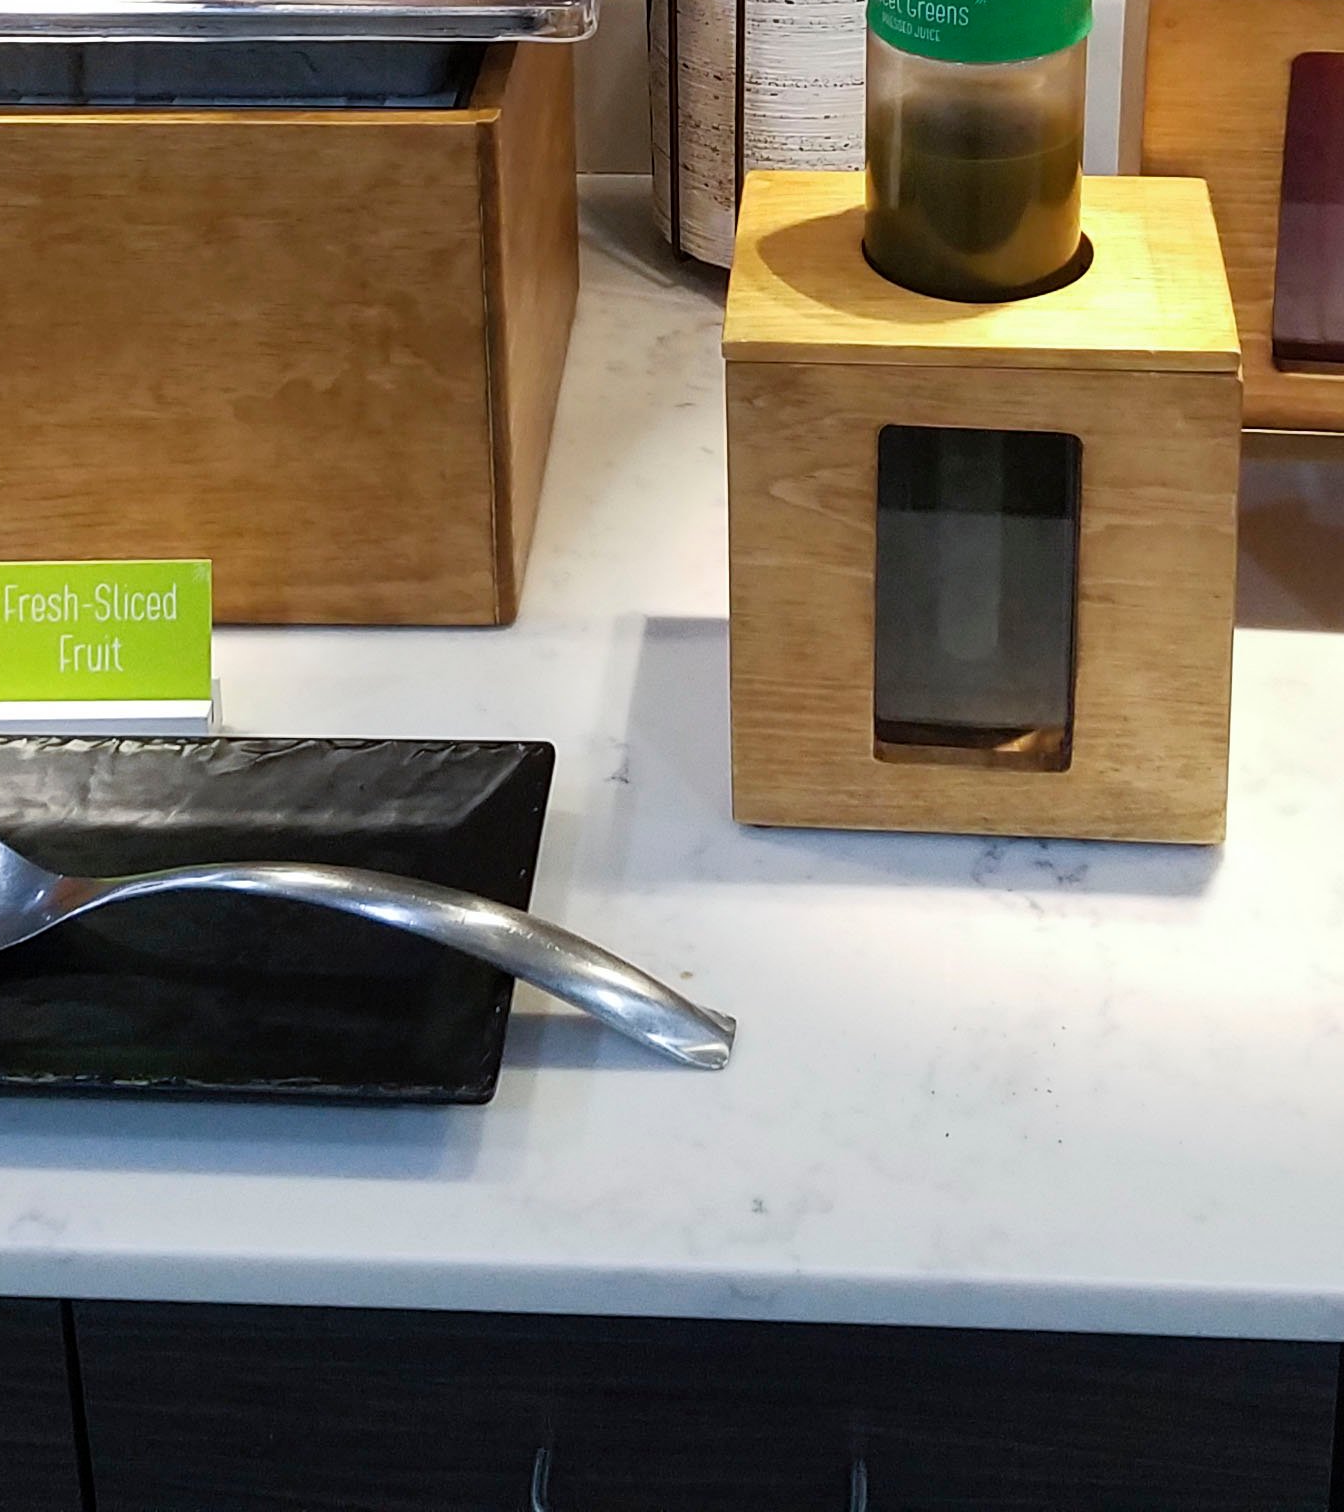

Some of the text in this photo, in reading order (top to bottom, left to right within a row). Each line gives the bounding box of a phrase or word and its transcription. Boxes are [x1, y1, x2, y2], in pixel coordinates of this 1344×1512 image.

[914, 25, 941, 42] JUICE
[4, 582, 177, 622] Fresh-Sliced
[58, 634, 124, 673] Fruit
